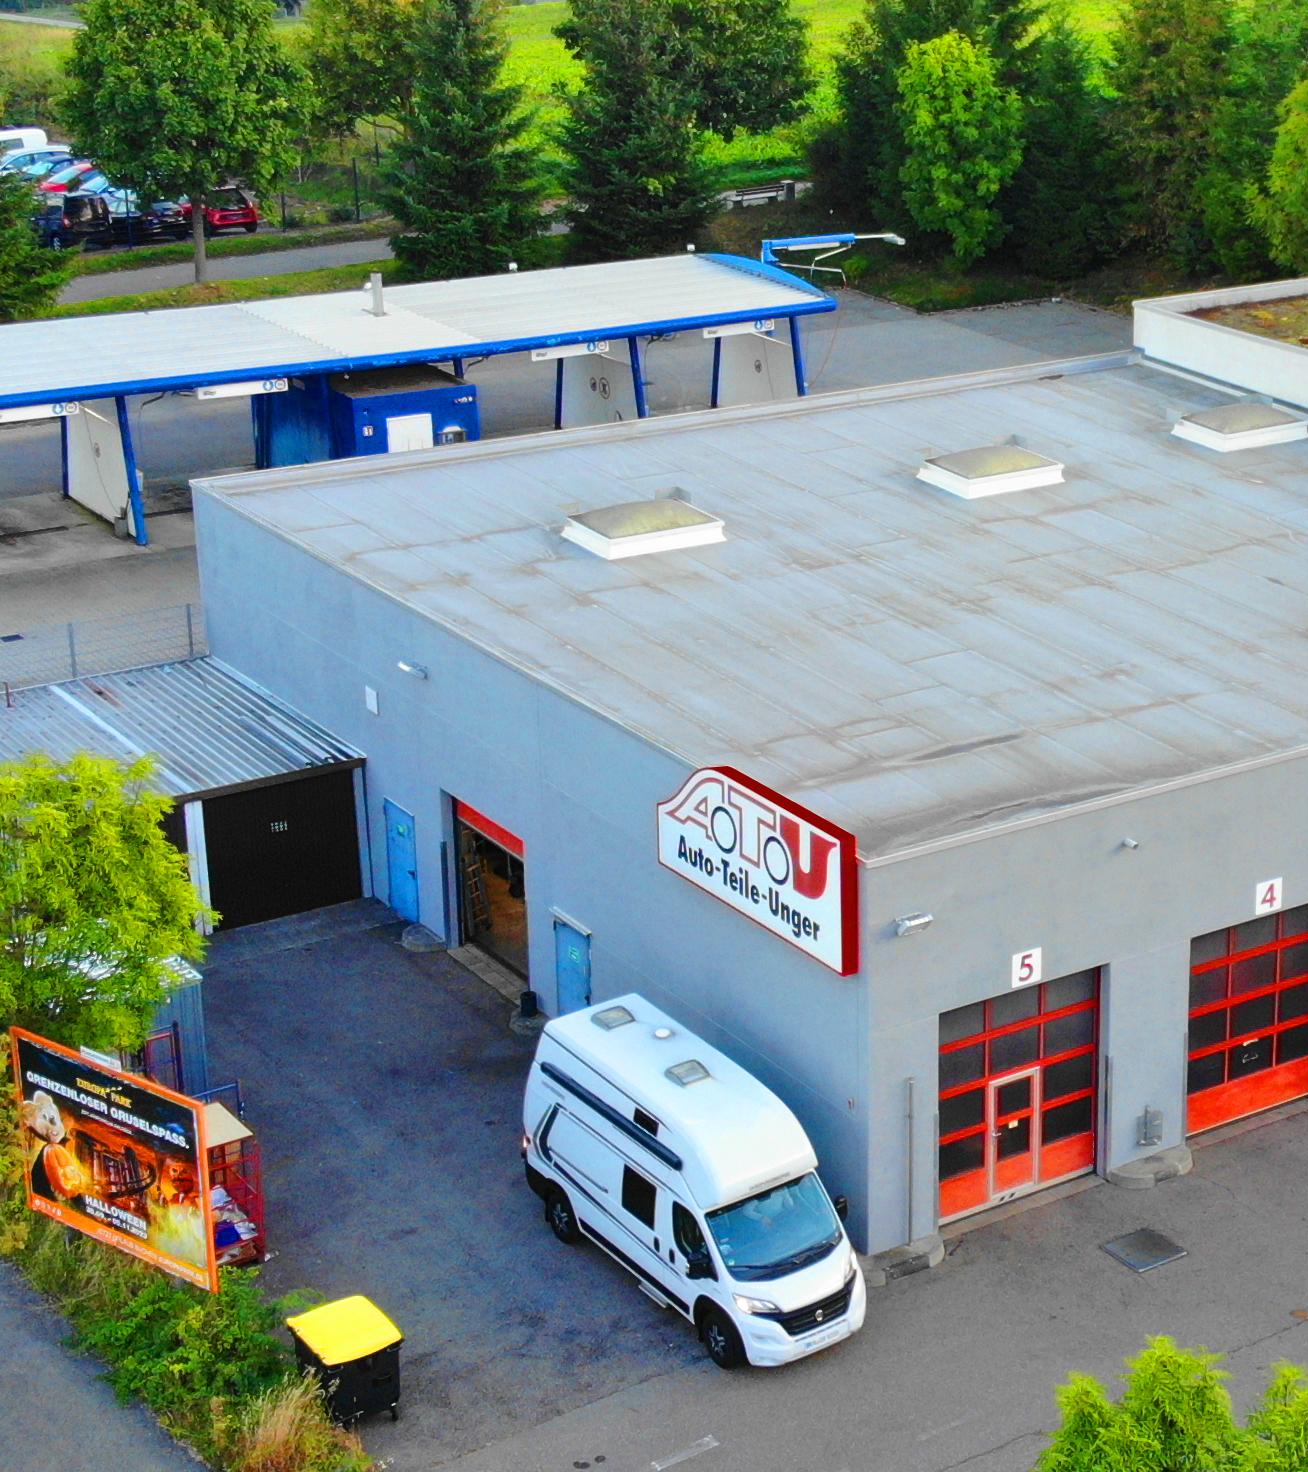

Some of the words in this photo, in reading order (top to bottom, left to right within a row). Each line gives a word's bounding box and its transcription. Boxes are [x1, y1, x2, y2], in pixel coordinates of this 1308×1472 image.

[677, 834, 821, 941] Auto-Teile-Unger
[1260, 883, 1277, 908] 4
[1018, 953, 1034, 982] 5
[26, 1070, 108, 1115] GRENZENLOSER
[85, 1193, 147, 1231] HALLOWEEN
